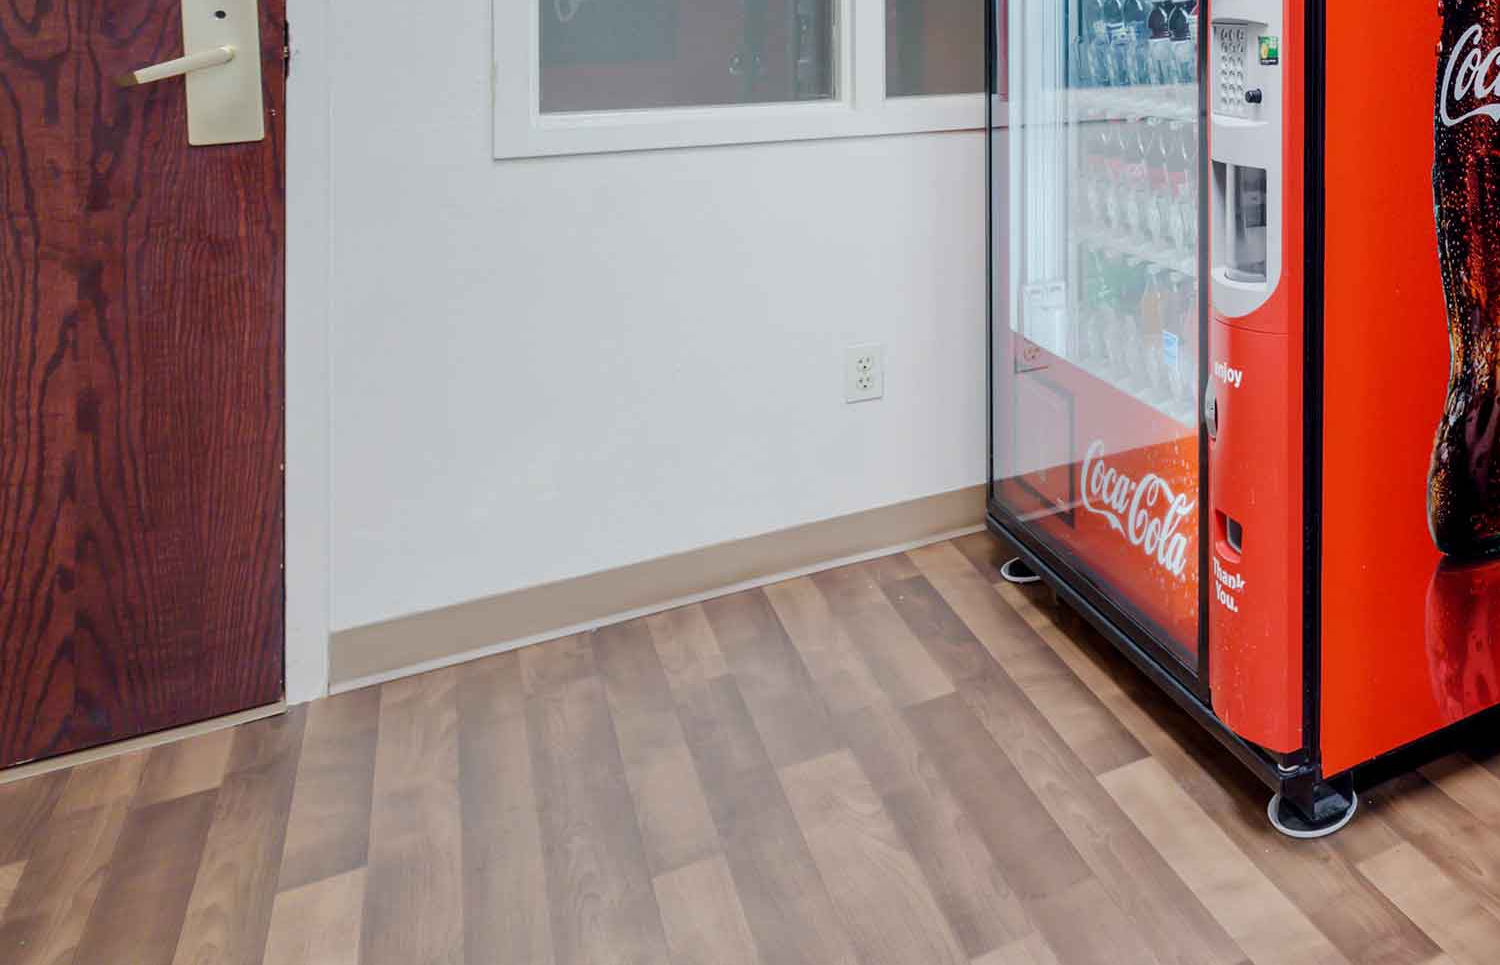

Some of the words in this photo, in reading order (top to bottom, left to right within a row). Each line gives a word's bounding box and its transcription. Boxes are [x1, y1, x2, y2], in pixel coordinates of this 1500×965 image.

[1081, 439, 1195, 577] Coca-Cola
[1213, 555, 1246, 590] Thank
[1215, 580, 1239, 613] You.
